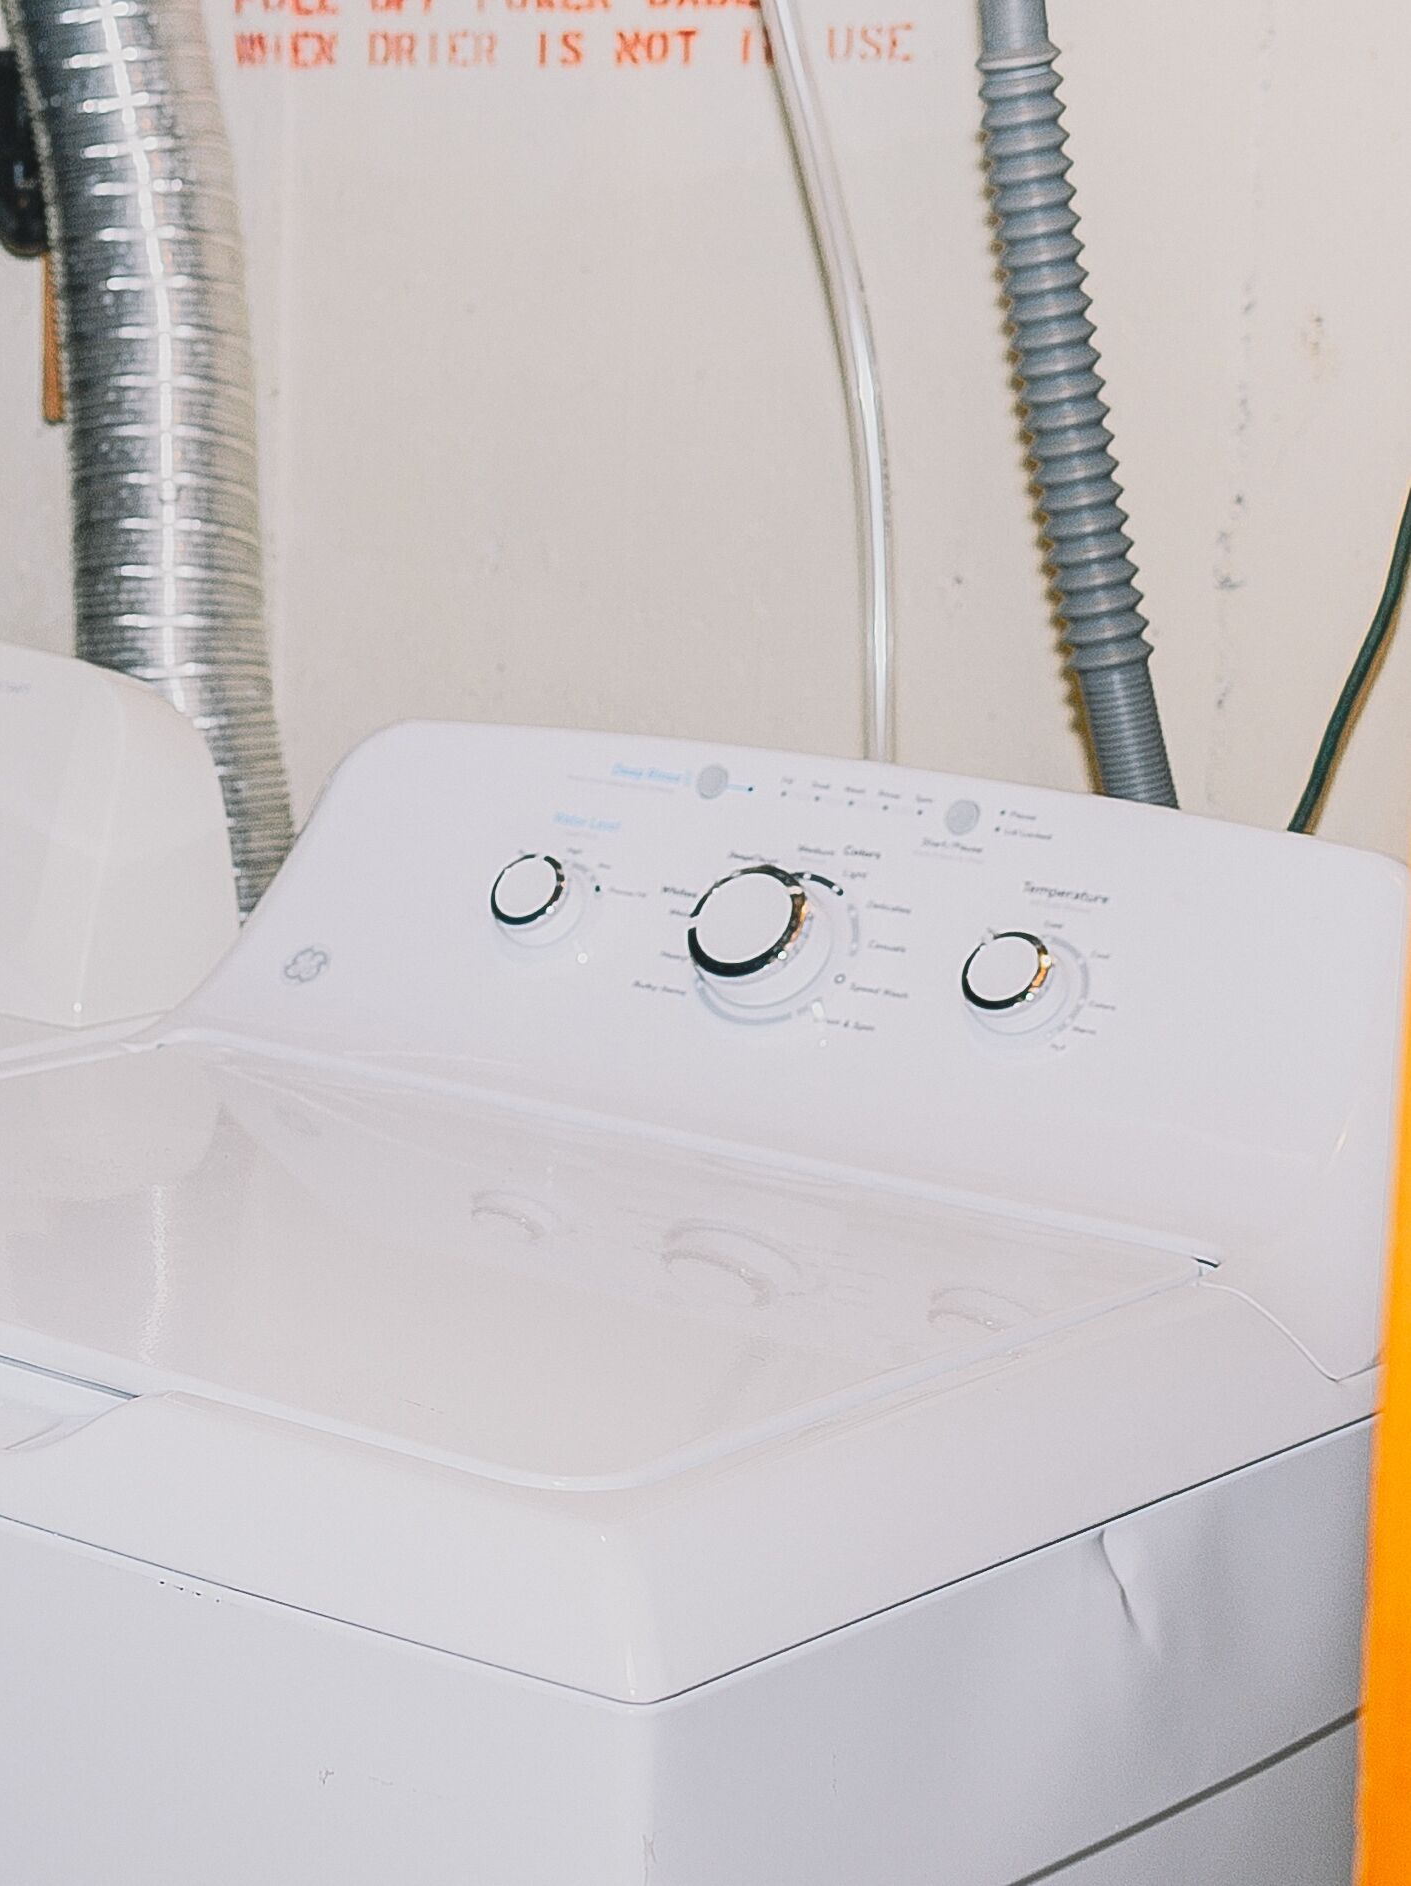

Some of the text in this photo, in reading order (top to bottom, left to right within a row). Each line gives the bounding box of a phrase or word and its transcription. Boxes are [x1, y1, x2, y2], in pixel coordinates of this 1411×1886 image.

[368, 31, 496, 67] DRIER
[537, 31, 585, 66] IS
[614, 29, 697, 65] NOT
[826, 22, 913, 61] USE
[1023, 880, 1109, 905] Temperature
